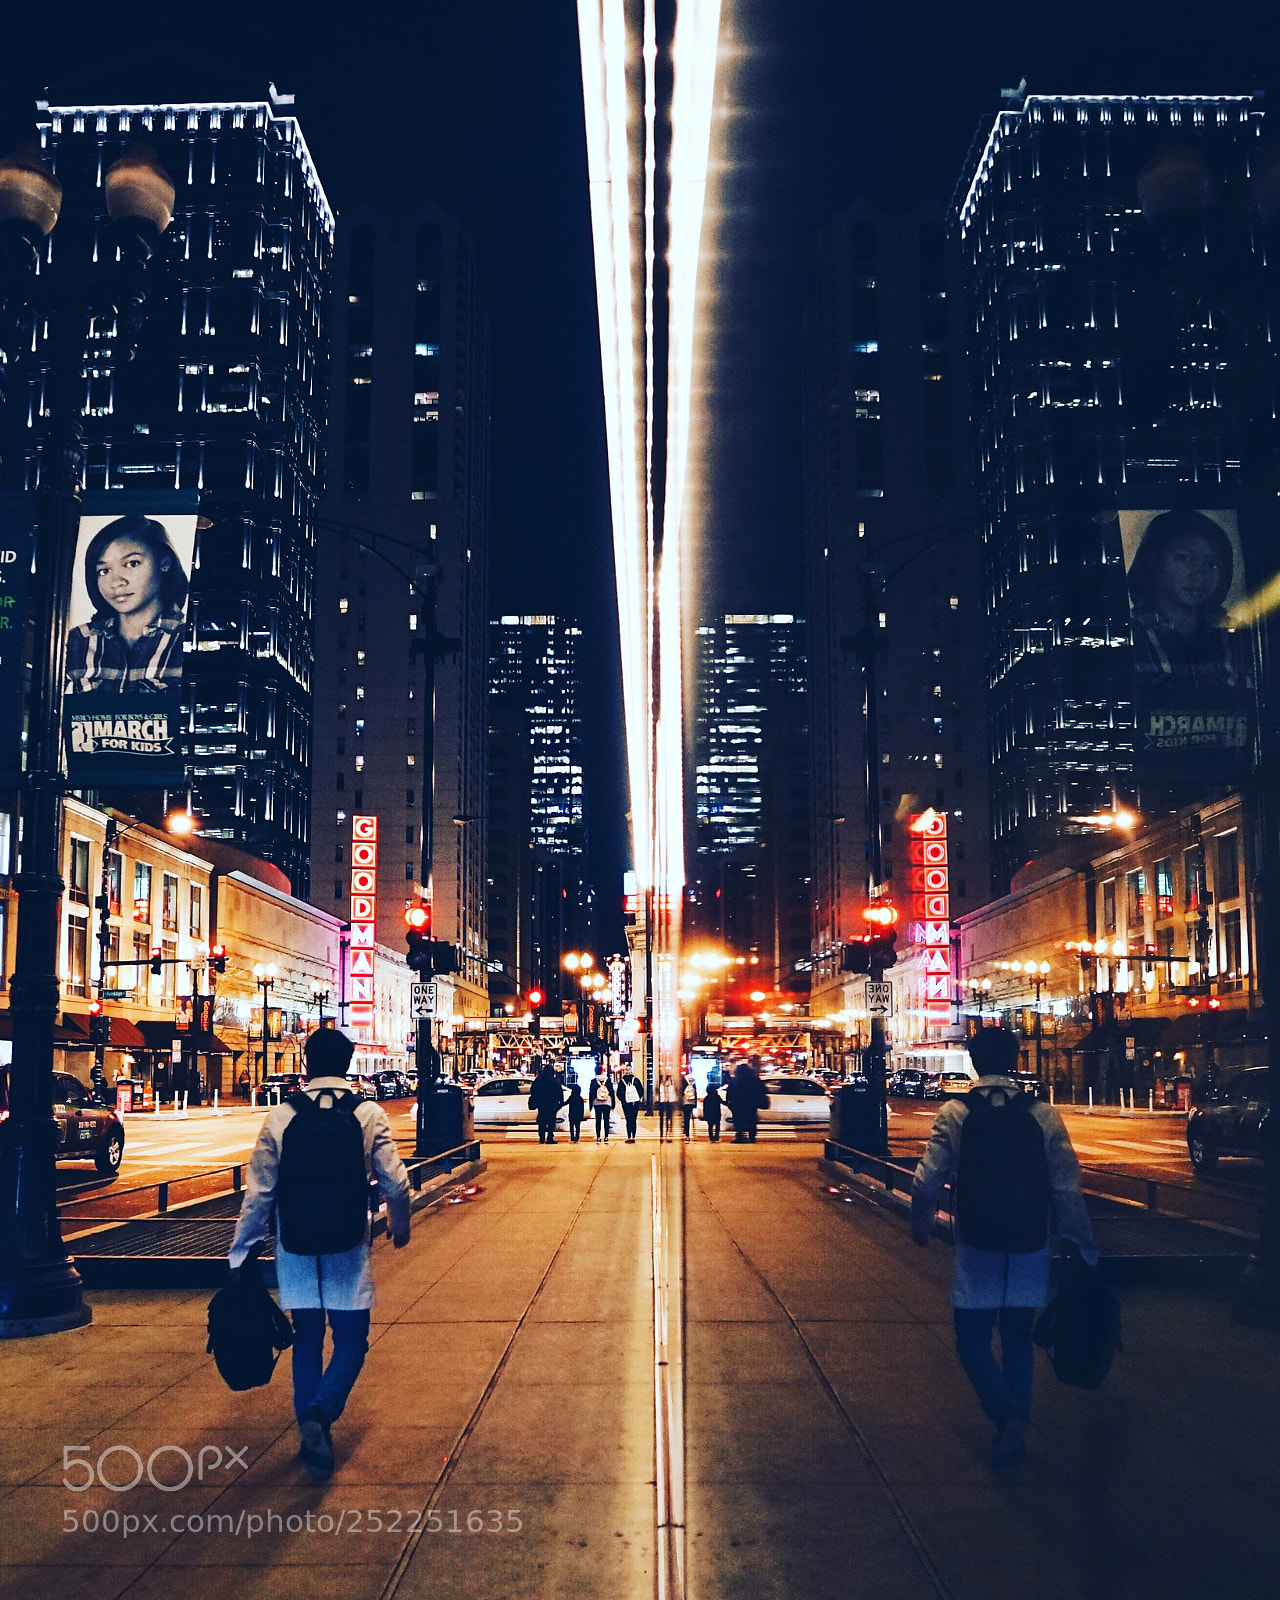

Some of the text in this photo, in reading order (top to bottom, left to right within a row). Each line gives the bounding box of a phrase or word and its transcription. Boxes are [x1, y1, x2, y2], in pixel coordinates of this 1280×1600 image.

[93, 720, 168, 740] MARCH
[101, 739, 162, 752] FOR KIDS
[352, 817, 376, 1001] GOODMAN
[414, 985, 434, 995] ONE
[413, 995, 435, 1005] WAY
